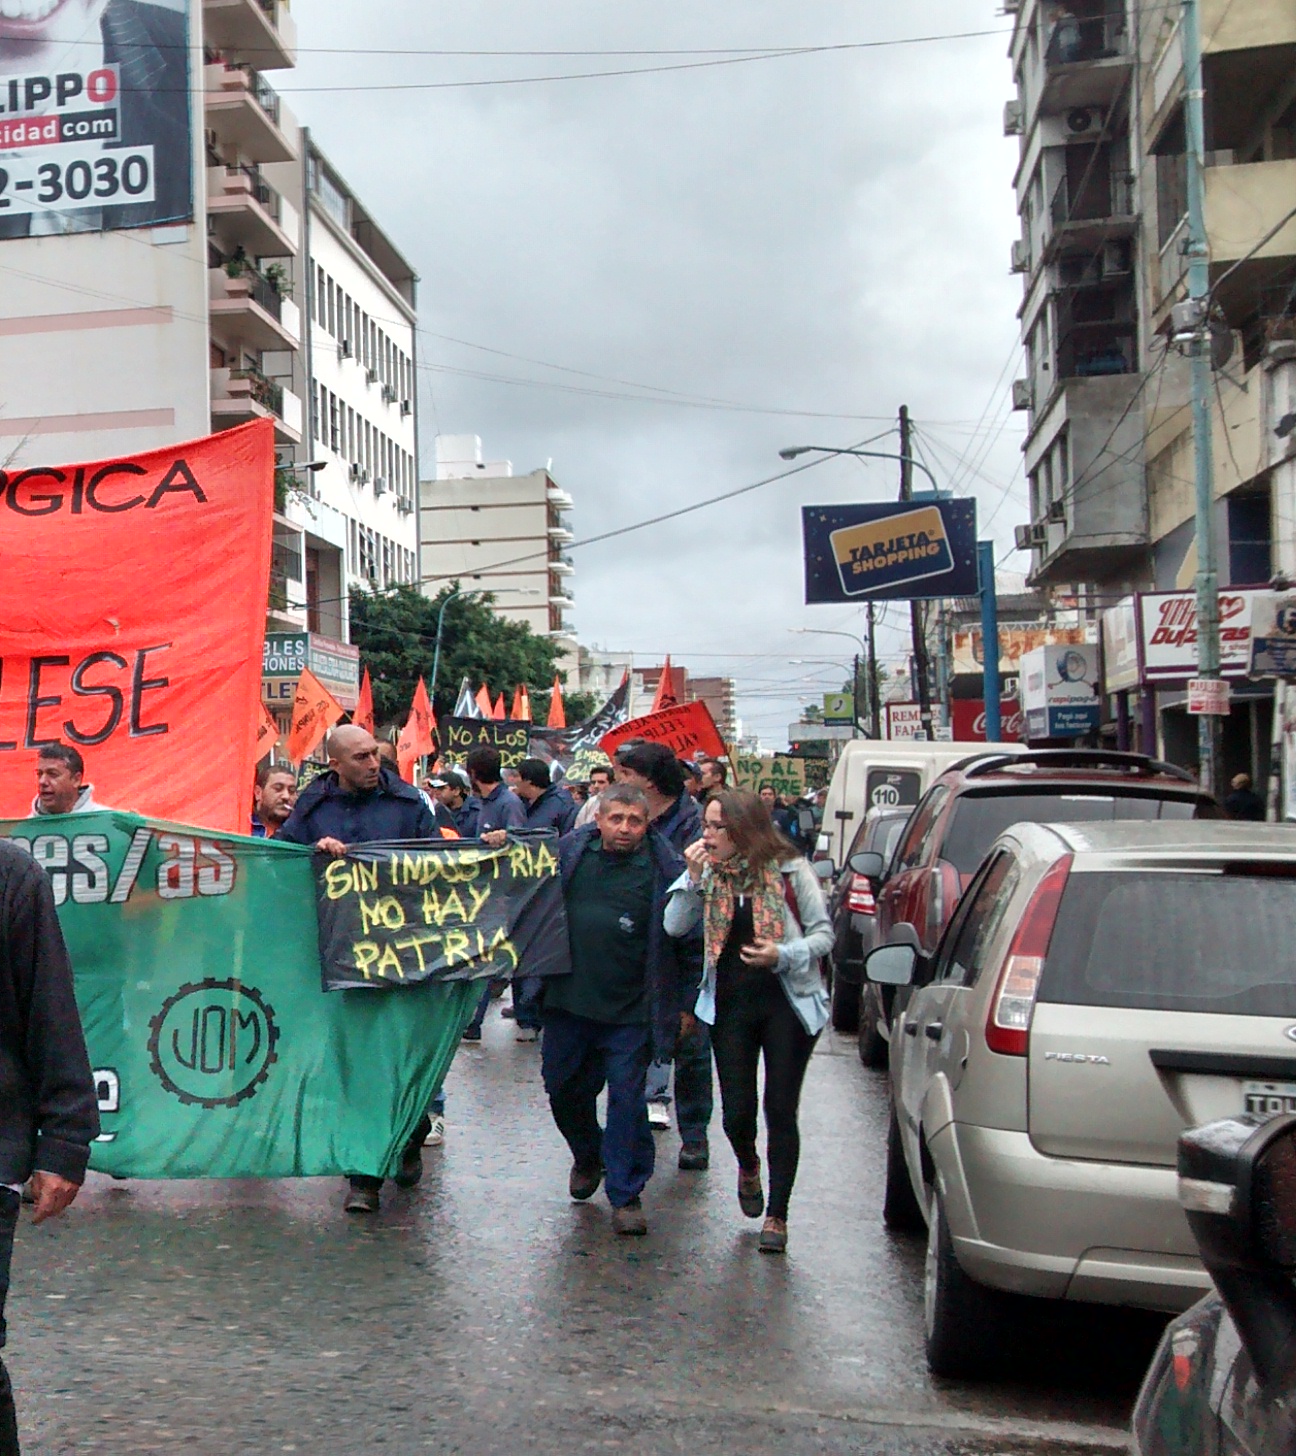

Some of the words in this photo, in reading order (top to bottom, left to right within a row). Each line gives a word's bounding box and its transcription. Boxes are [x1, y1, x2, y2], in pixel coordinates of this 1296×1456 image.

[849, 531, 931, 561] TARJETA
[851, 542, 940, 574] SHOPPING
[448, 725, 473, 746] NO
[478, 725, 490, 744] A
[737, 760, 763, 777] NO
[771, 760, 798, 776] AL
[874, 789, 897, 805] 110
[325, 859, 378, 900] SIN
[391, 841, 558, 886] INDUSTRIA
[359, 895, 406, 936] NO
[422, 882, 491, 926] HAY
[353, 926, 519, 980] PATRIA
[1044, 1051, 1111, 1066] FIESTA
